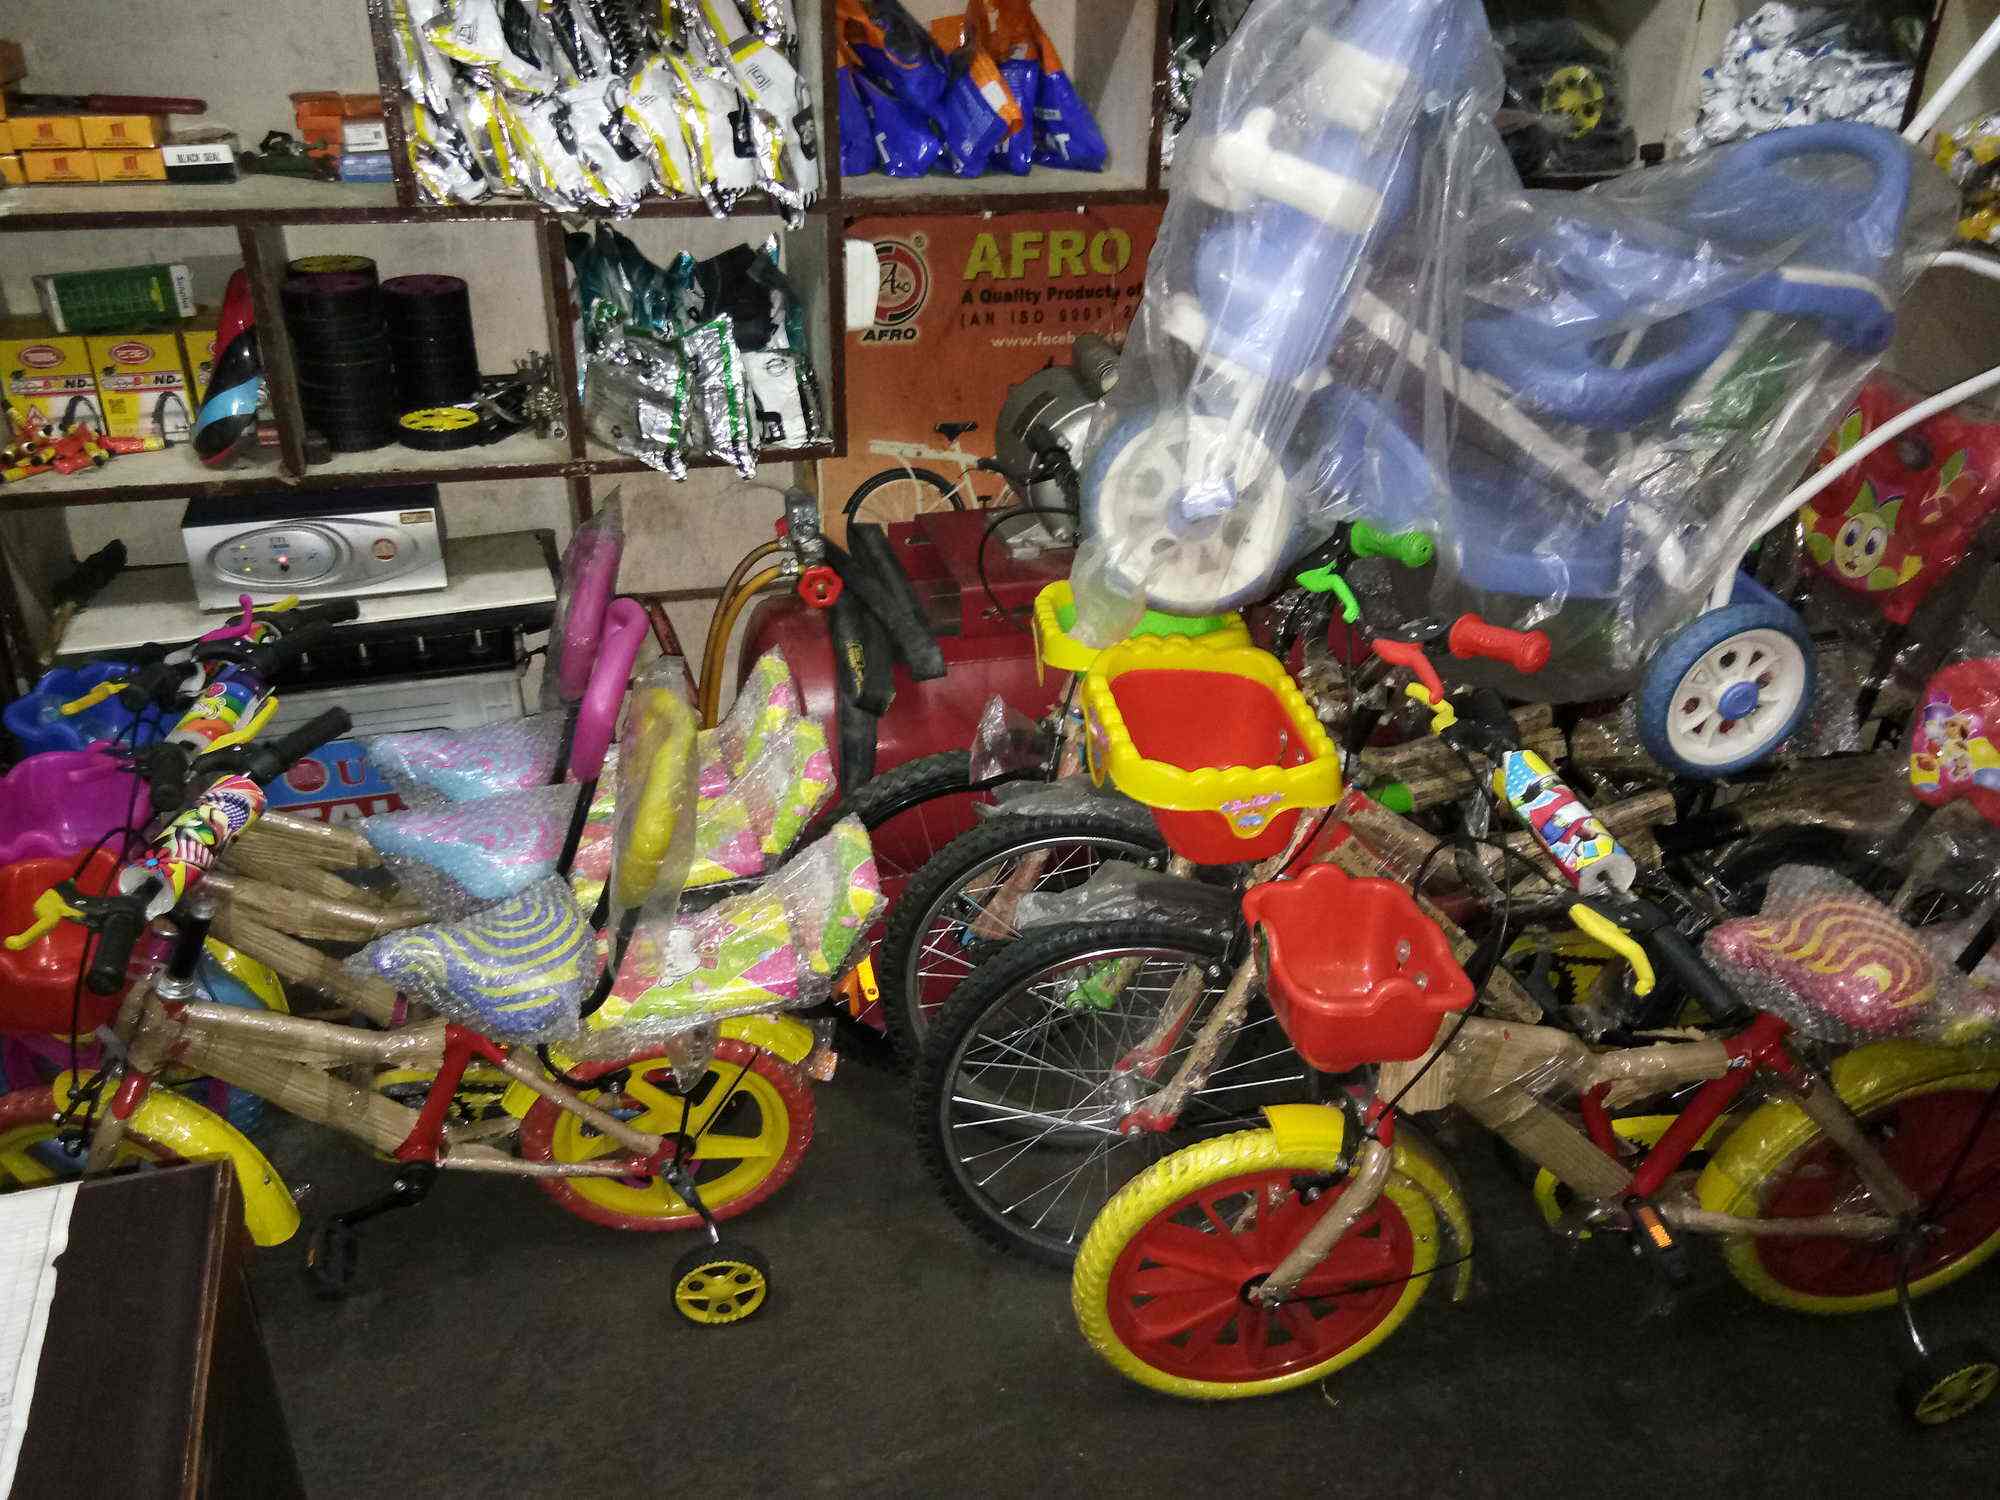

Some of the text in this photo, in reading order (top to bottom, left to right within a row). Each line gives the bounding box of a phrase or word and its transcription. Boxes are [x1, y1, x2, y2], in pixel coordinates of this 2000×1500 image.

[963, 228, 1132, 281] AFRO
[961, 290, 973, 304] A
[979, 288, 1041, 306] Quality
[861, 327, 918, 343] AFRO
